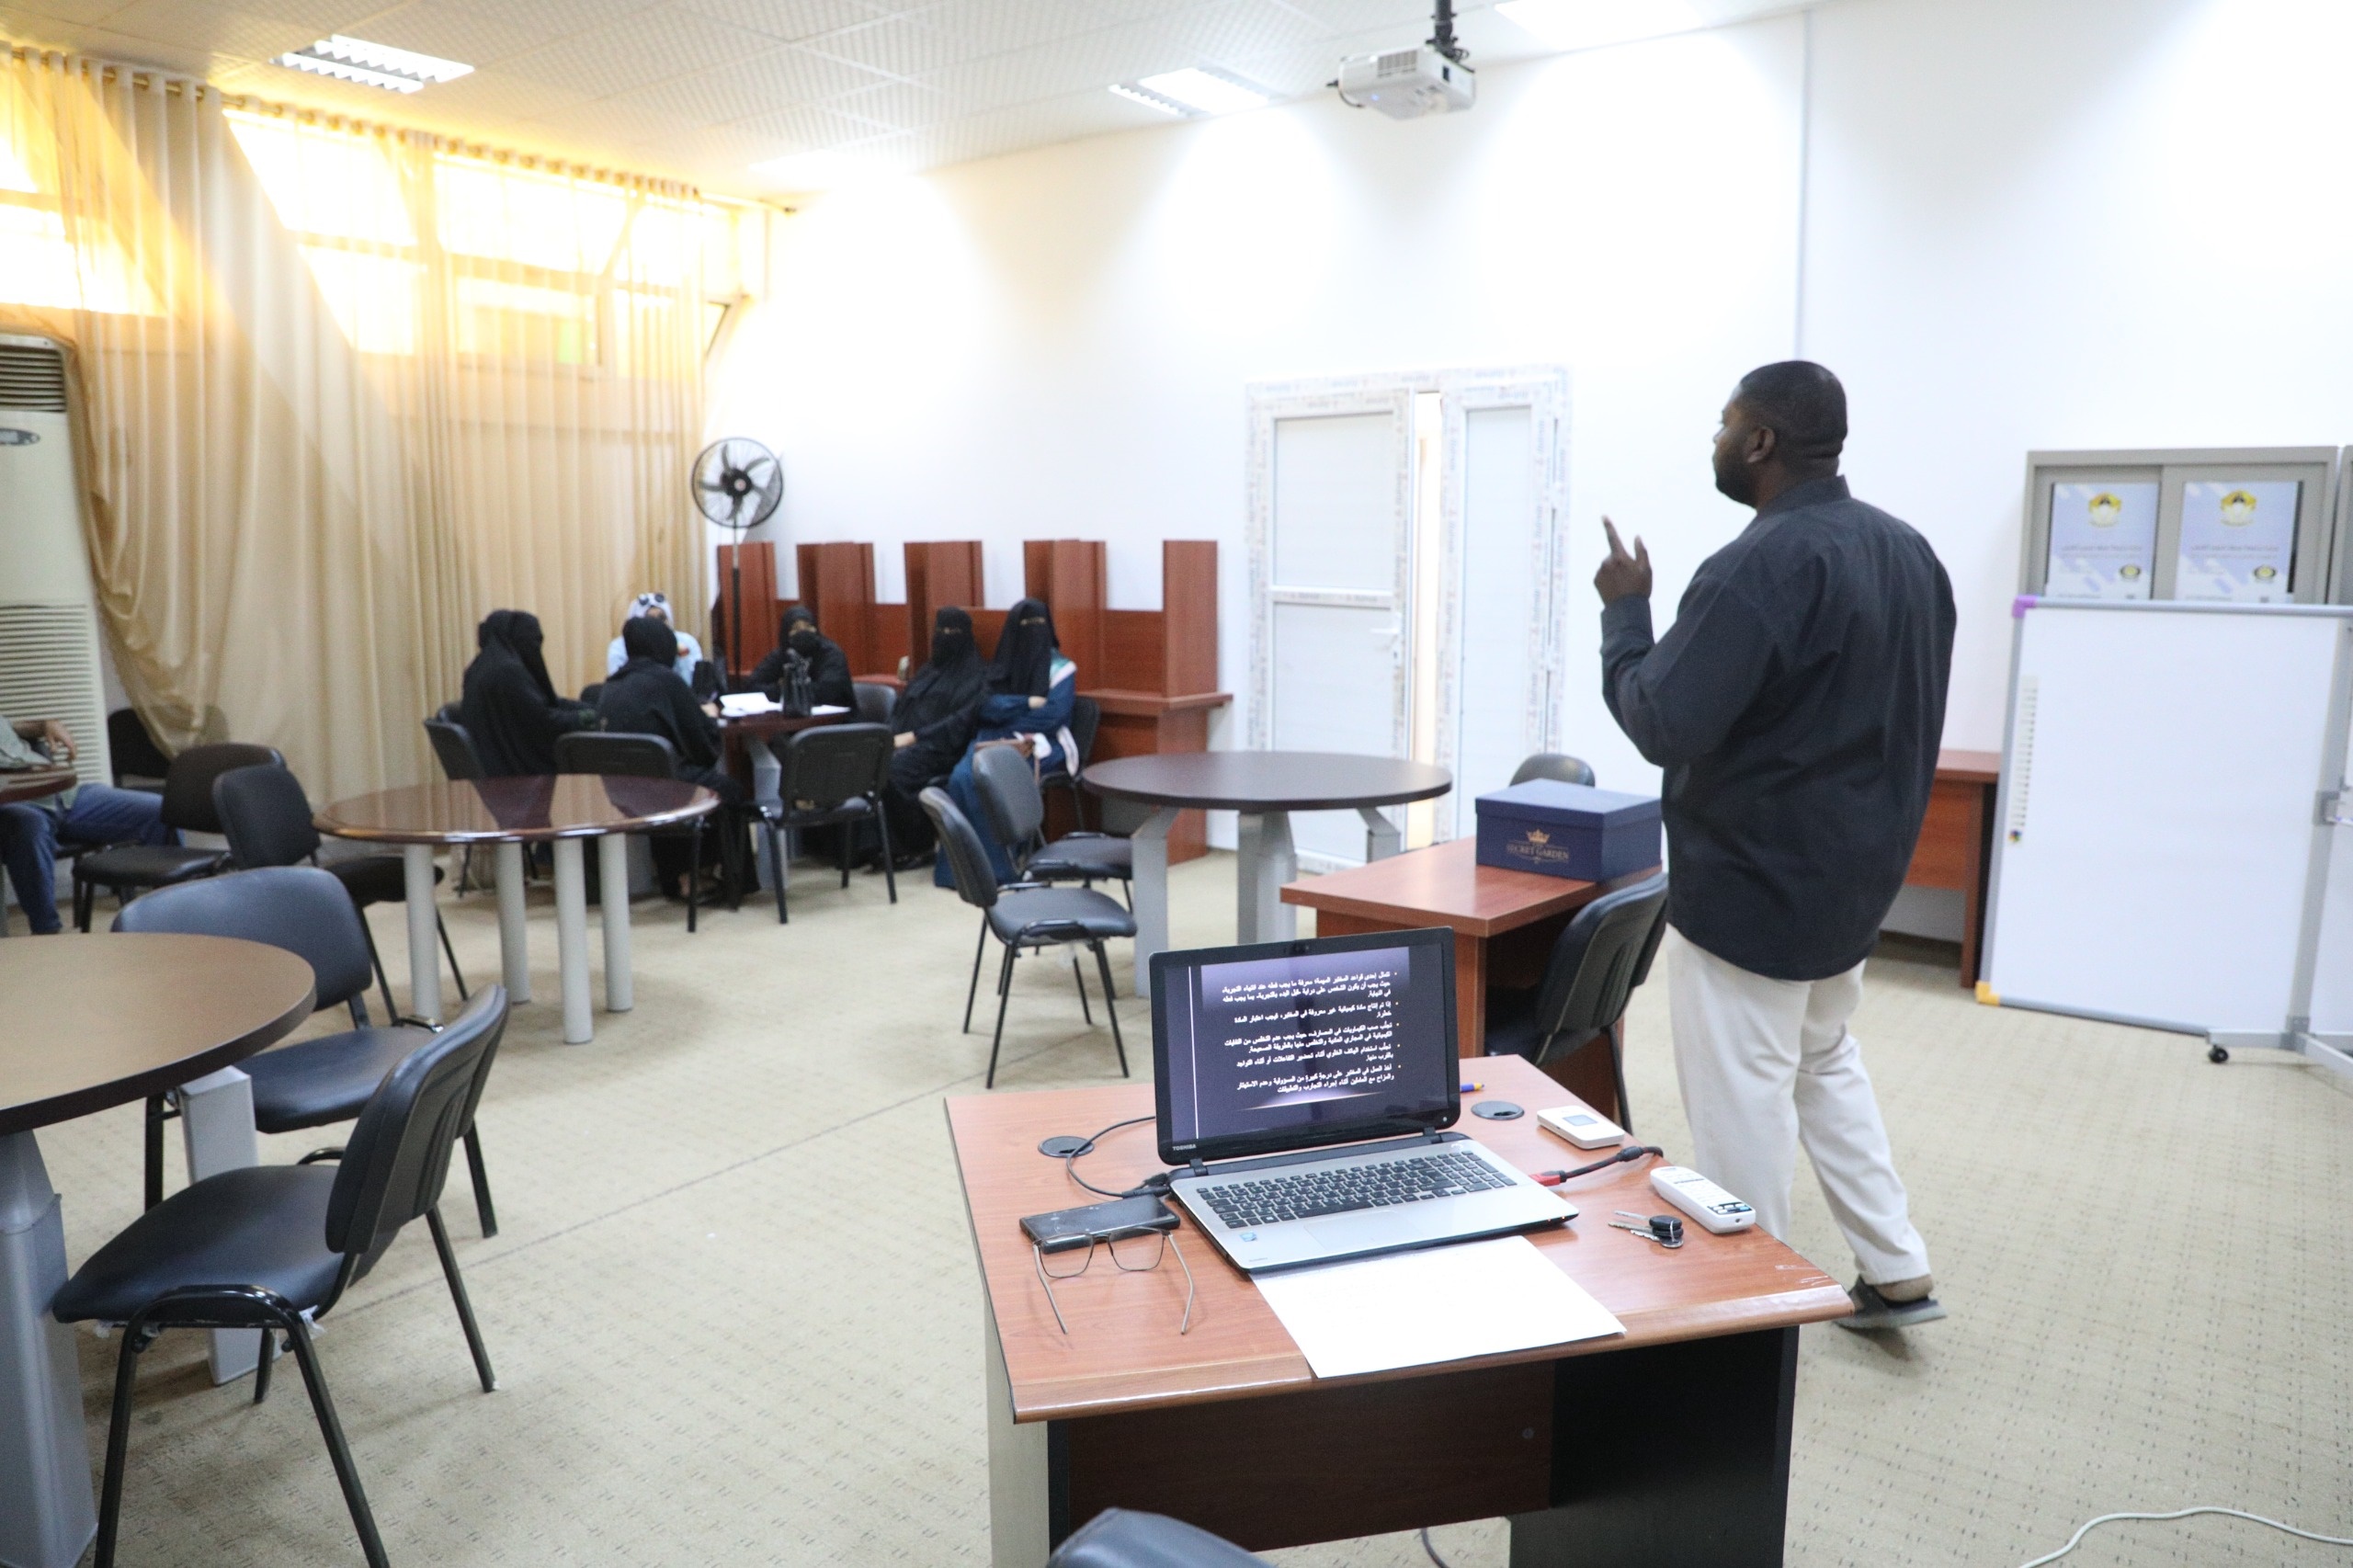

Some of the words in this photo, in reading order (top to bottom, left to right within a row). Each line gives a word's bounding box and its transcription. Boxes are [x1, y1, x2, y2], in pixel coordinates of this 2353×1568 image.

[1347, 983, 1359, 992] يكون
[1360, 981, 1366, 990] أن
[1316, 986, 1326, 994] على
[1383, 989, 1391, 997] في
[1300, 1009, 1308, 1018] في
[1308, 1008, 1326, 1017] معروفة
[1334, 1028, 1341, 1036] في
[1364, 1033, 1371, 1041] في
[1266, 1056, 1271, 1064] أو
[1333, 1070, 1343, 1079] على
